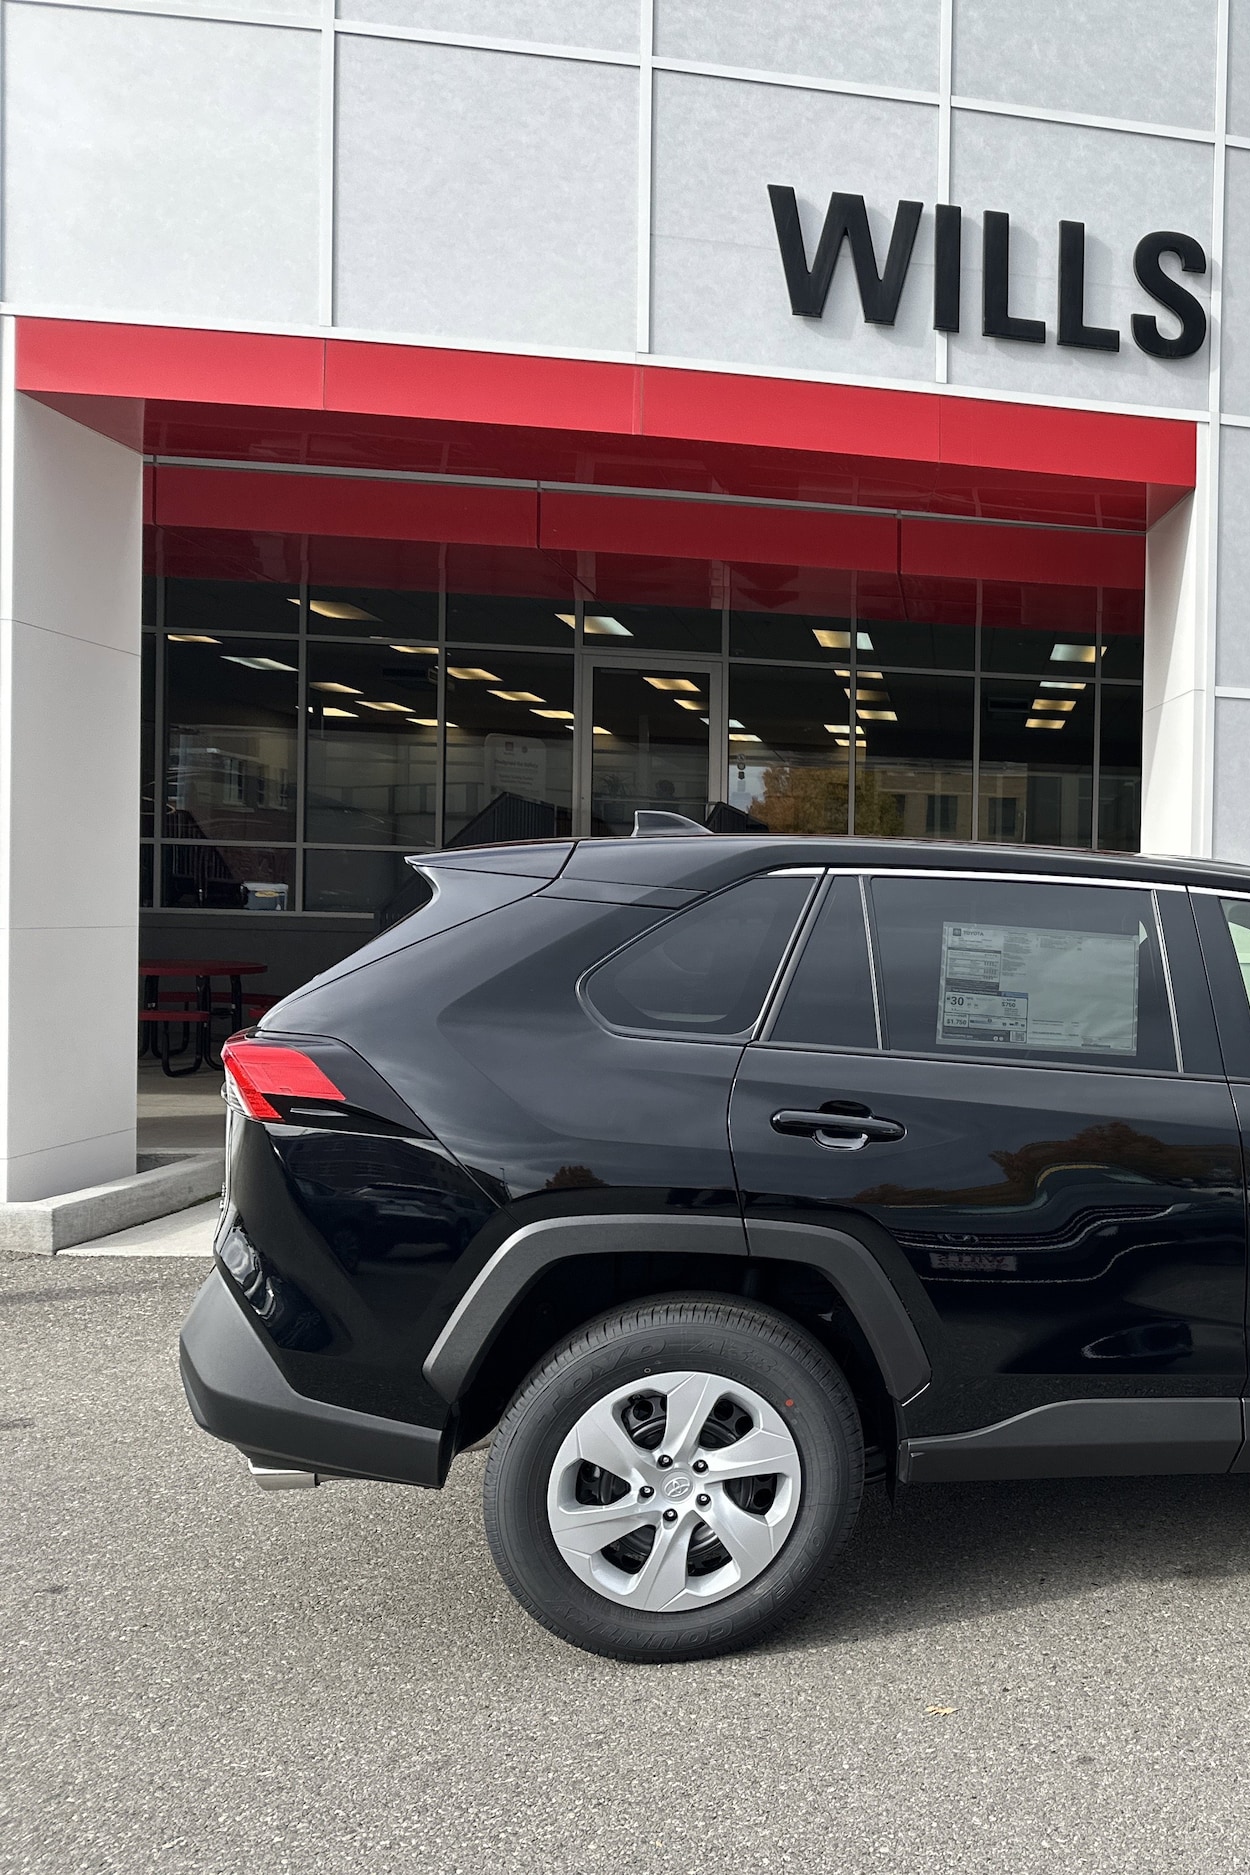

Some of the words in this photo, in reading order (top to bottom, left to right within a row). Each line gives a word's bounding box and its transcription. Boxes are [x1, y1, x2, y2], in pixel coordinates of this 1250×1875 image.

[767, 184, 1207, 359] WILLS
[951, 996, 964, 1006] 30
[537, 1338, 666, 1422] TOYO
